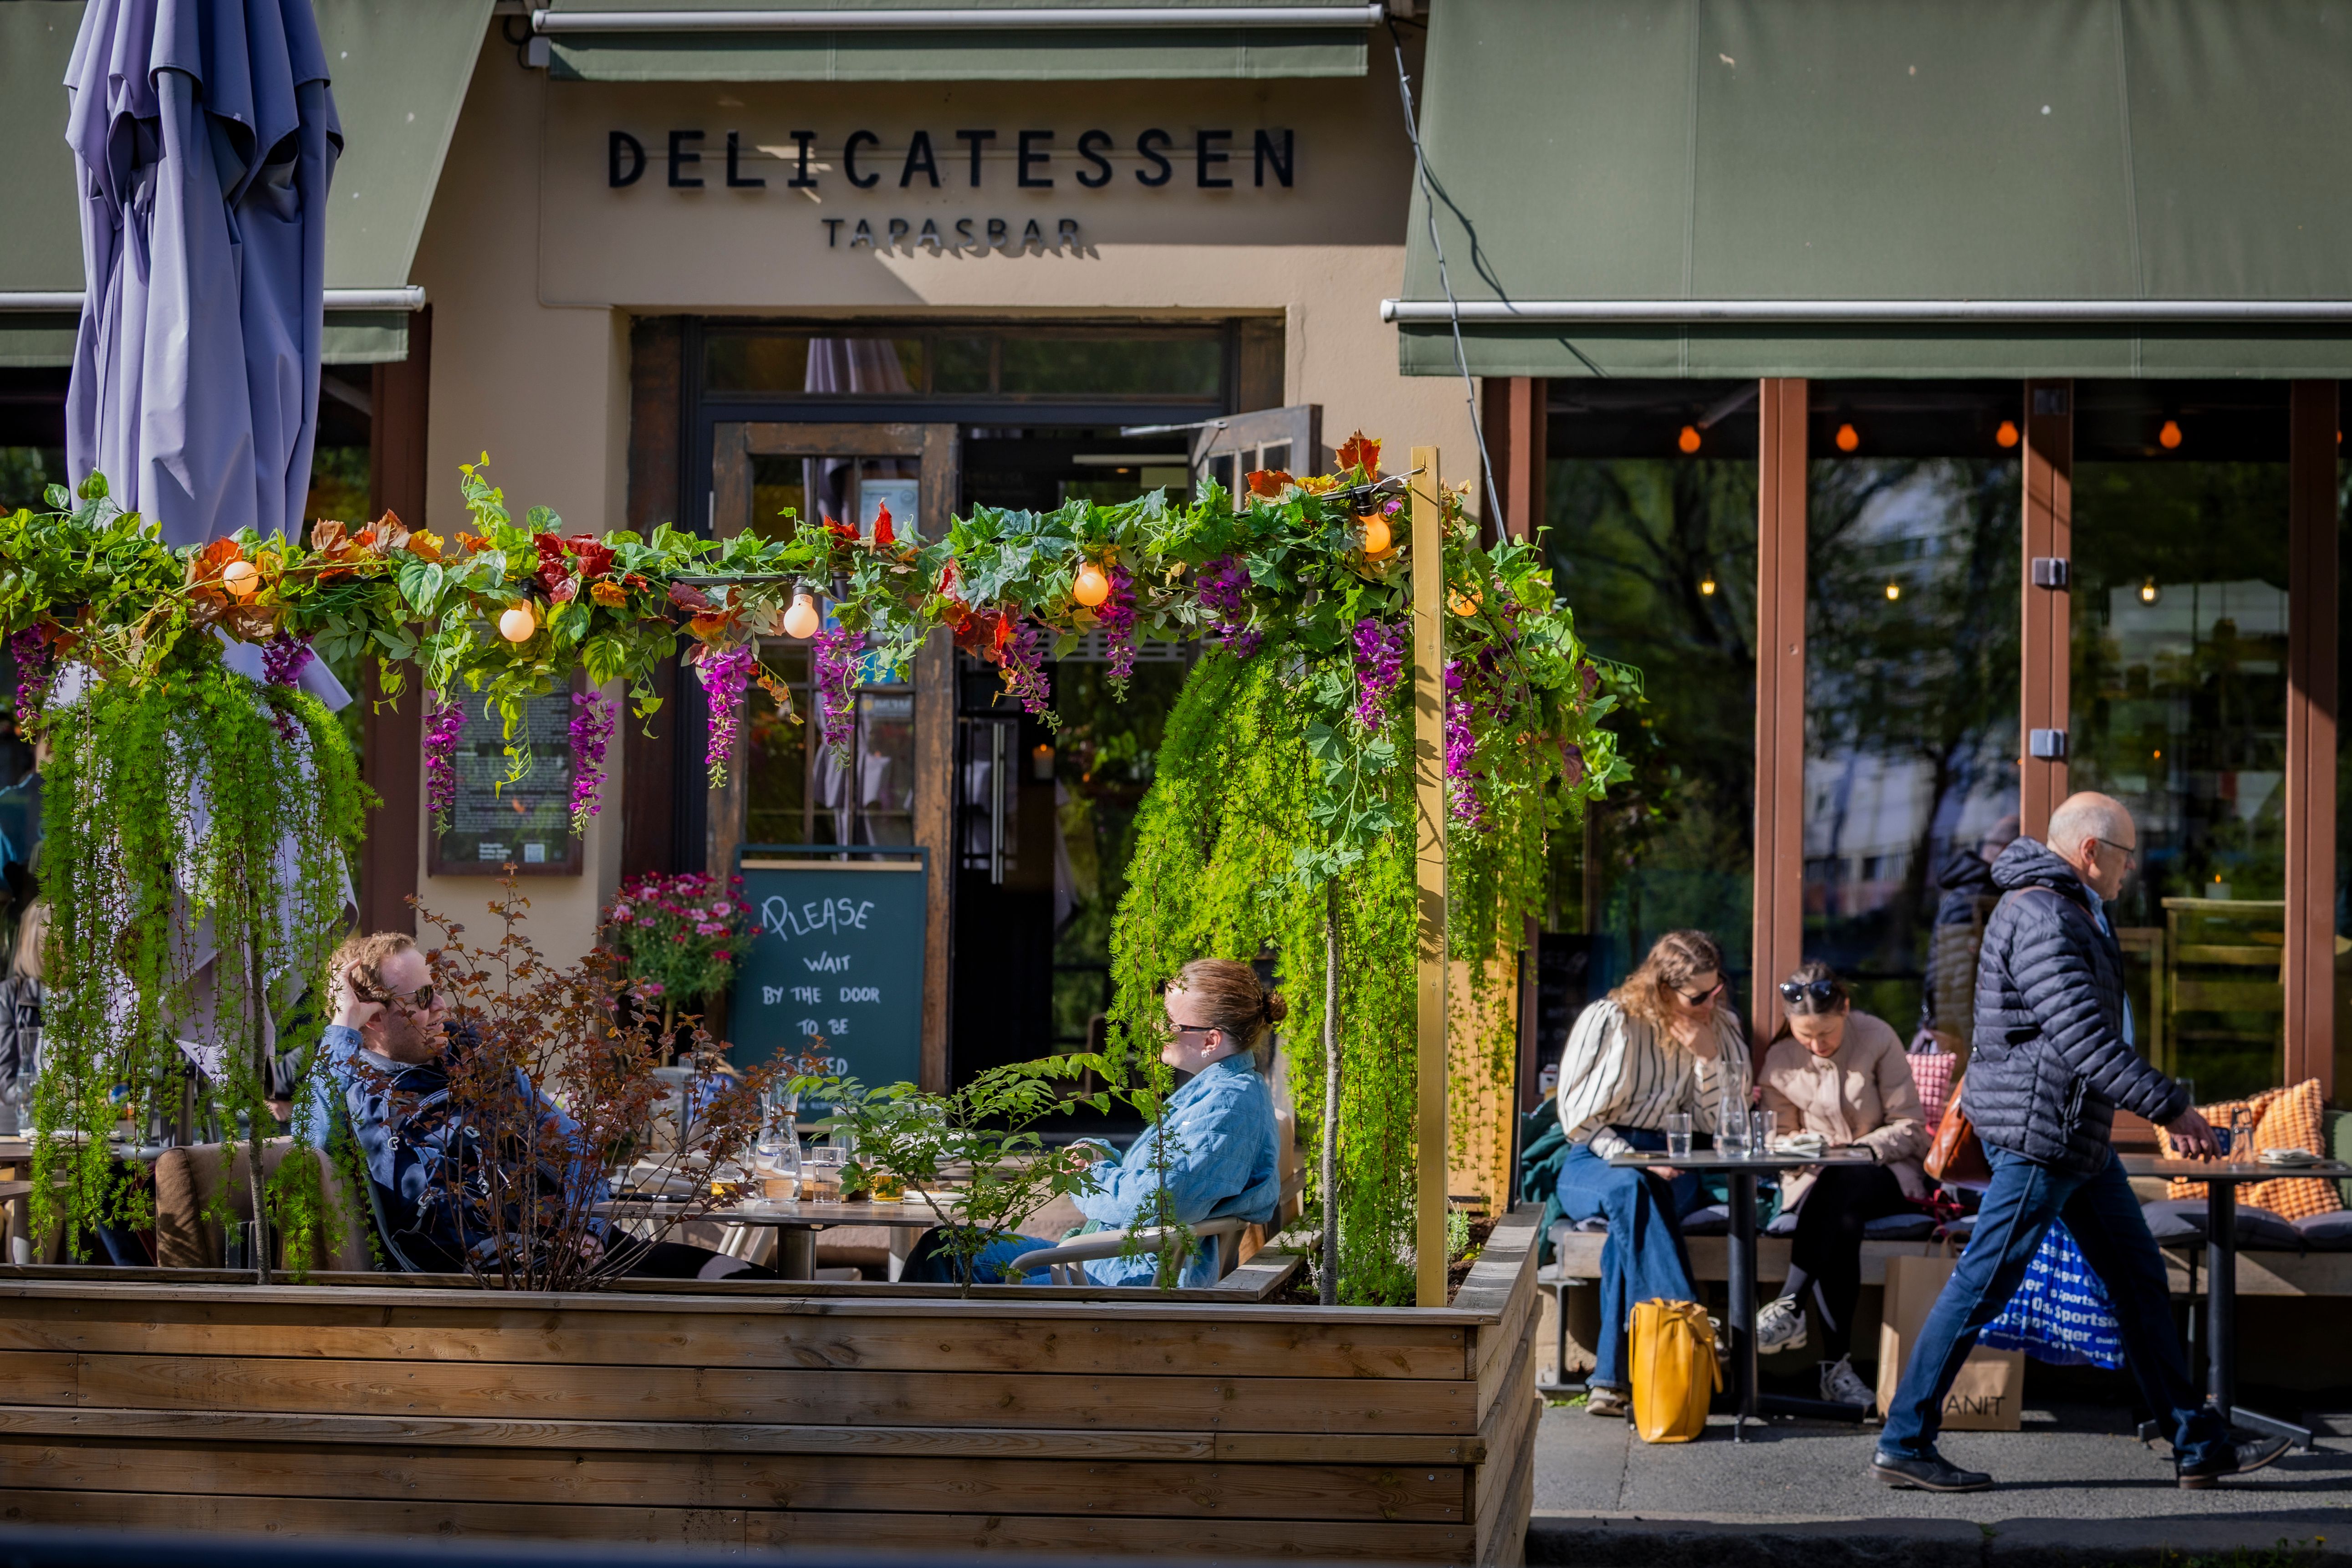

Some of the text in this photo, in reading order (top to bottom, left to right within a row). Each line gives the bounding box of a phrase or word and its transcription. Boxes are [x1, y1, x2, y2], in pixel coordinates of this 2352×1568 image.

[608, 128, 1294, 188] DELICATESSEN
[821, 219, 1081, 249] TAPASBAR
[761, 895, 875, 941] PLEASE
[803, 950, 851, 974] WAIT
[762, 986, 880, 1005] BY THE DOOR
[796, 1018, 849, 1036] TO BE
